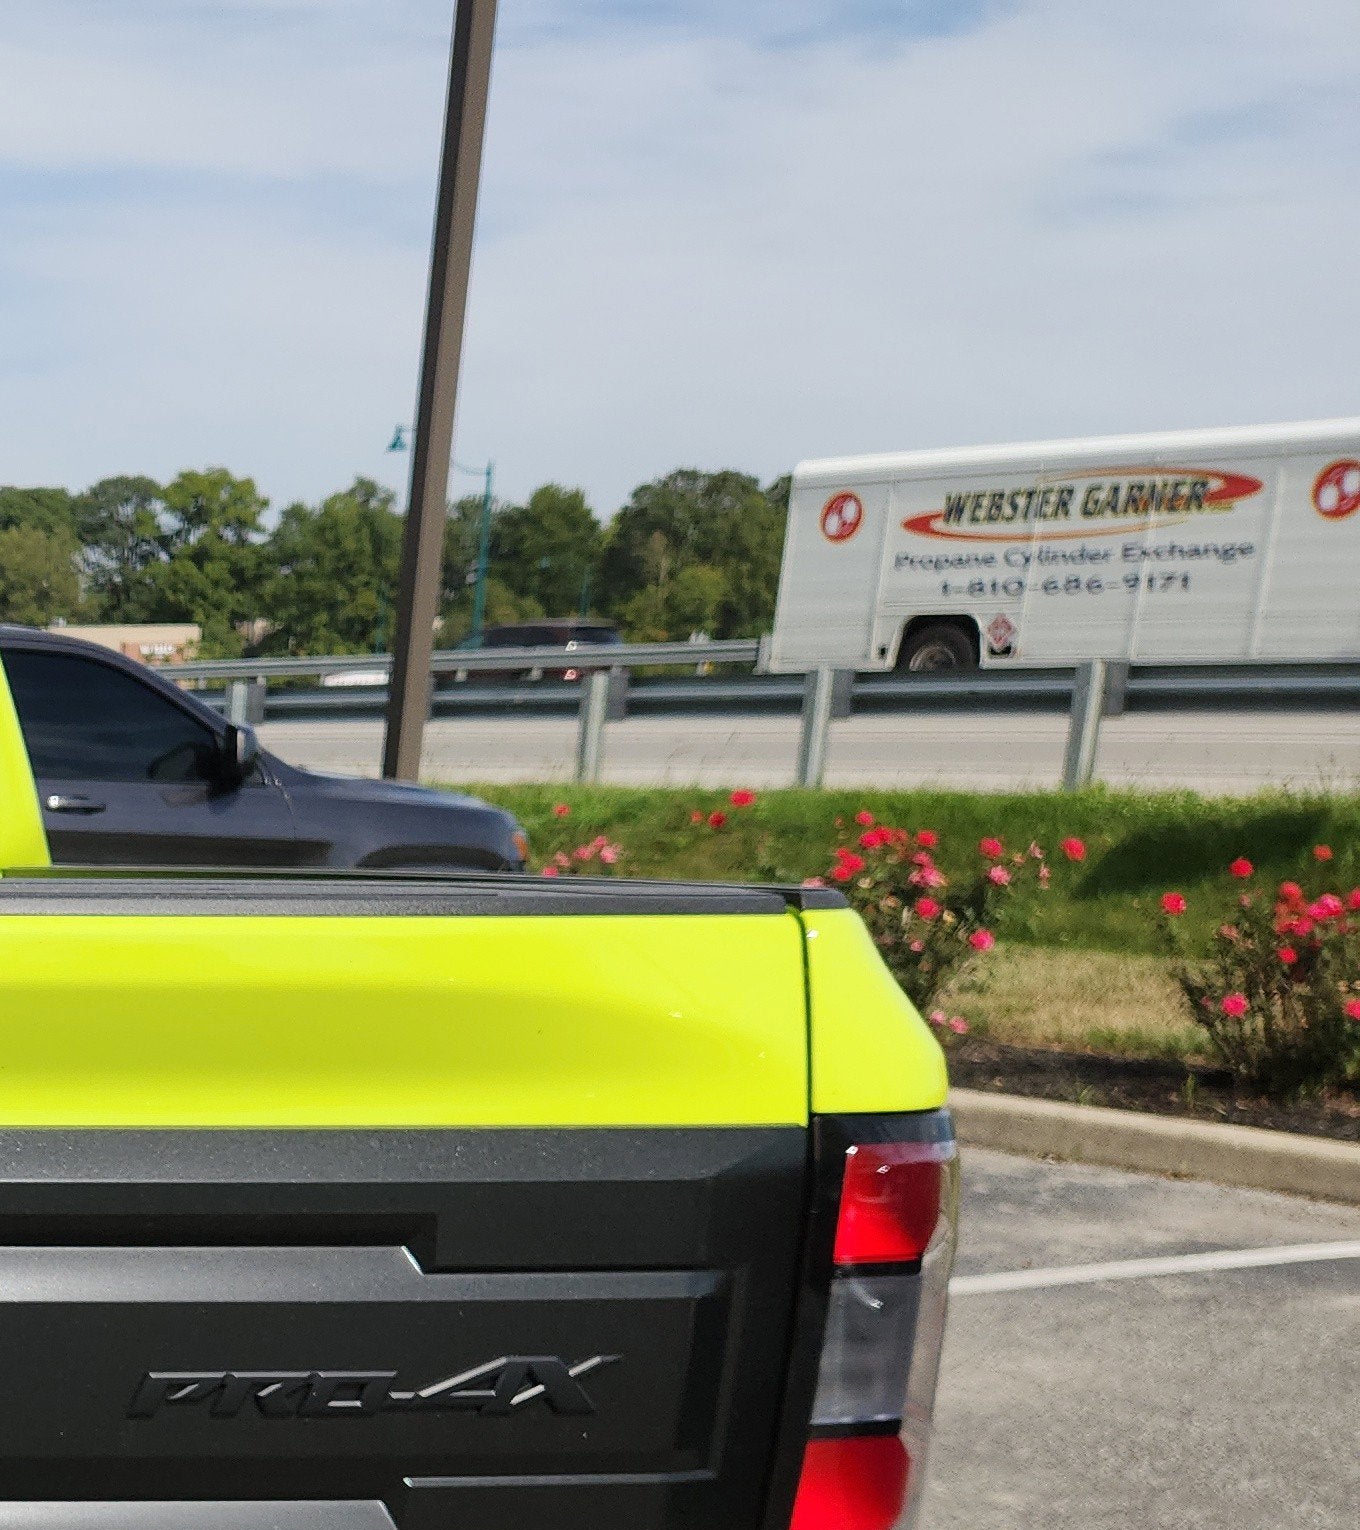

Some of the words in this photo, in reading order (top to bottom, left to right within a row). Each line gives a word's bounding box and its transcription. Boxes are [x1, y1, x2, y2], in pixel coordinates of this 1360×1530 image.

[943, 484, 1074, 525] WEBSTER
[1078, 478, 1210, 520] GARNER
[893, 550, 997, 573] Propane
[1121, 541, 1255, 567] Exchange
